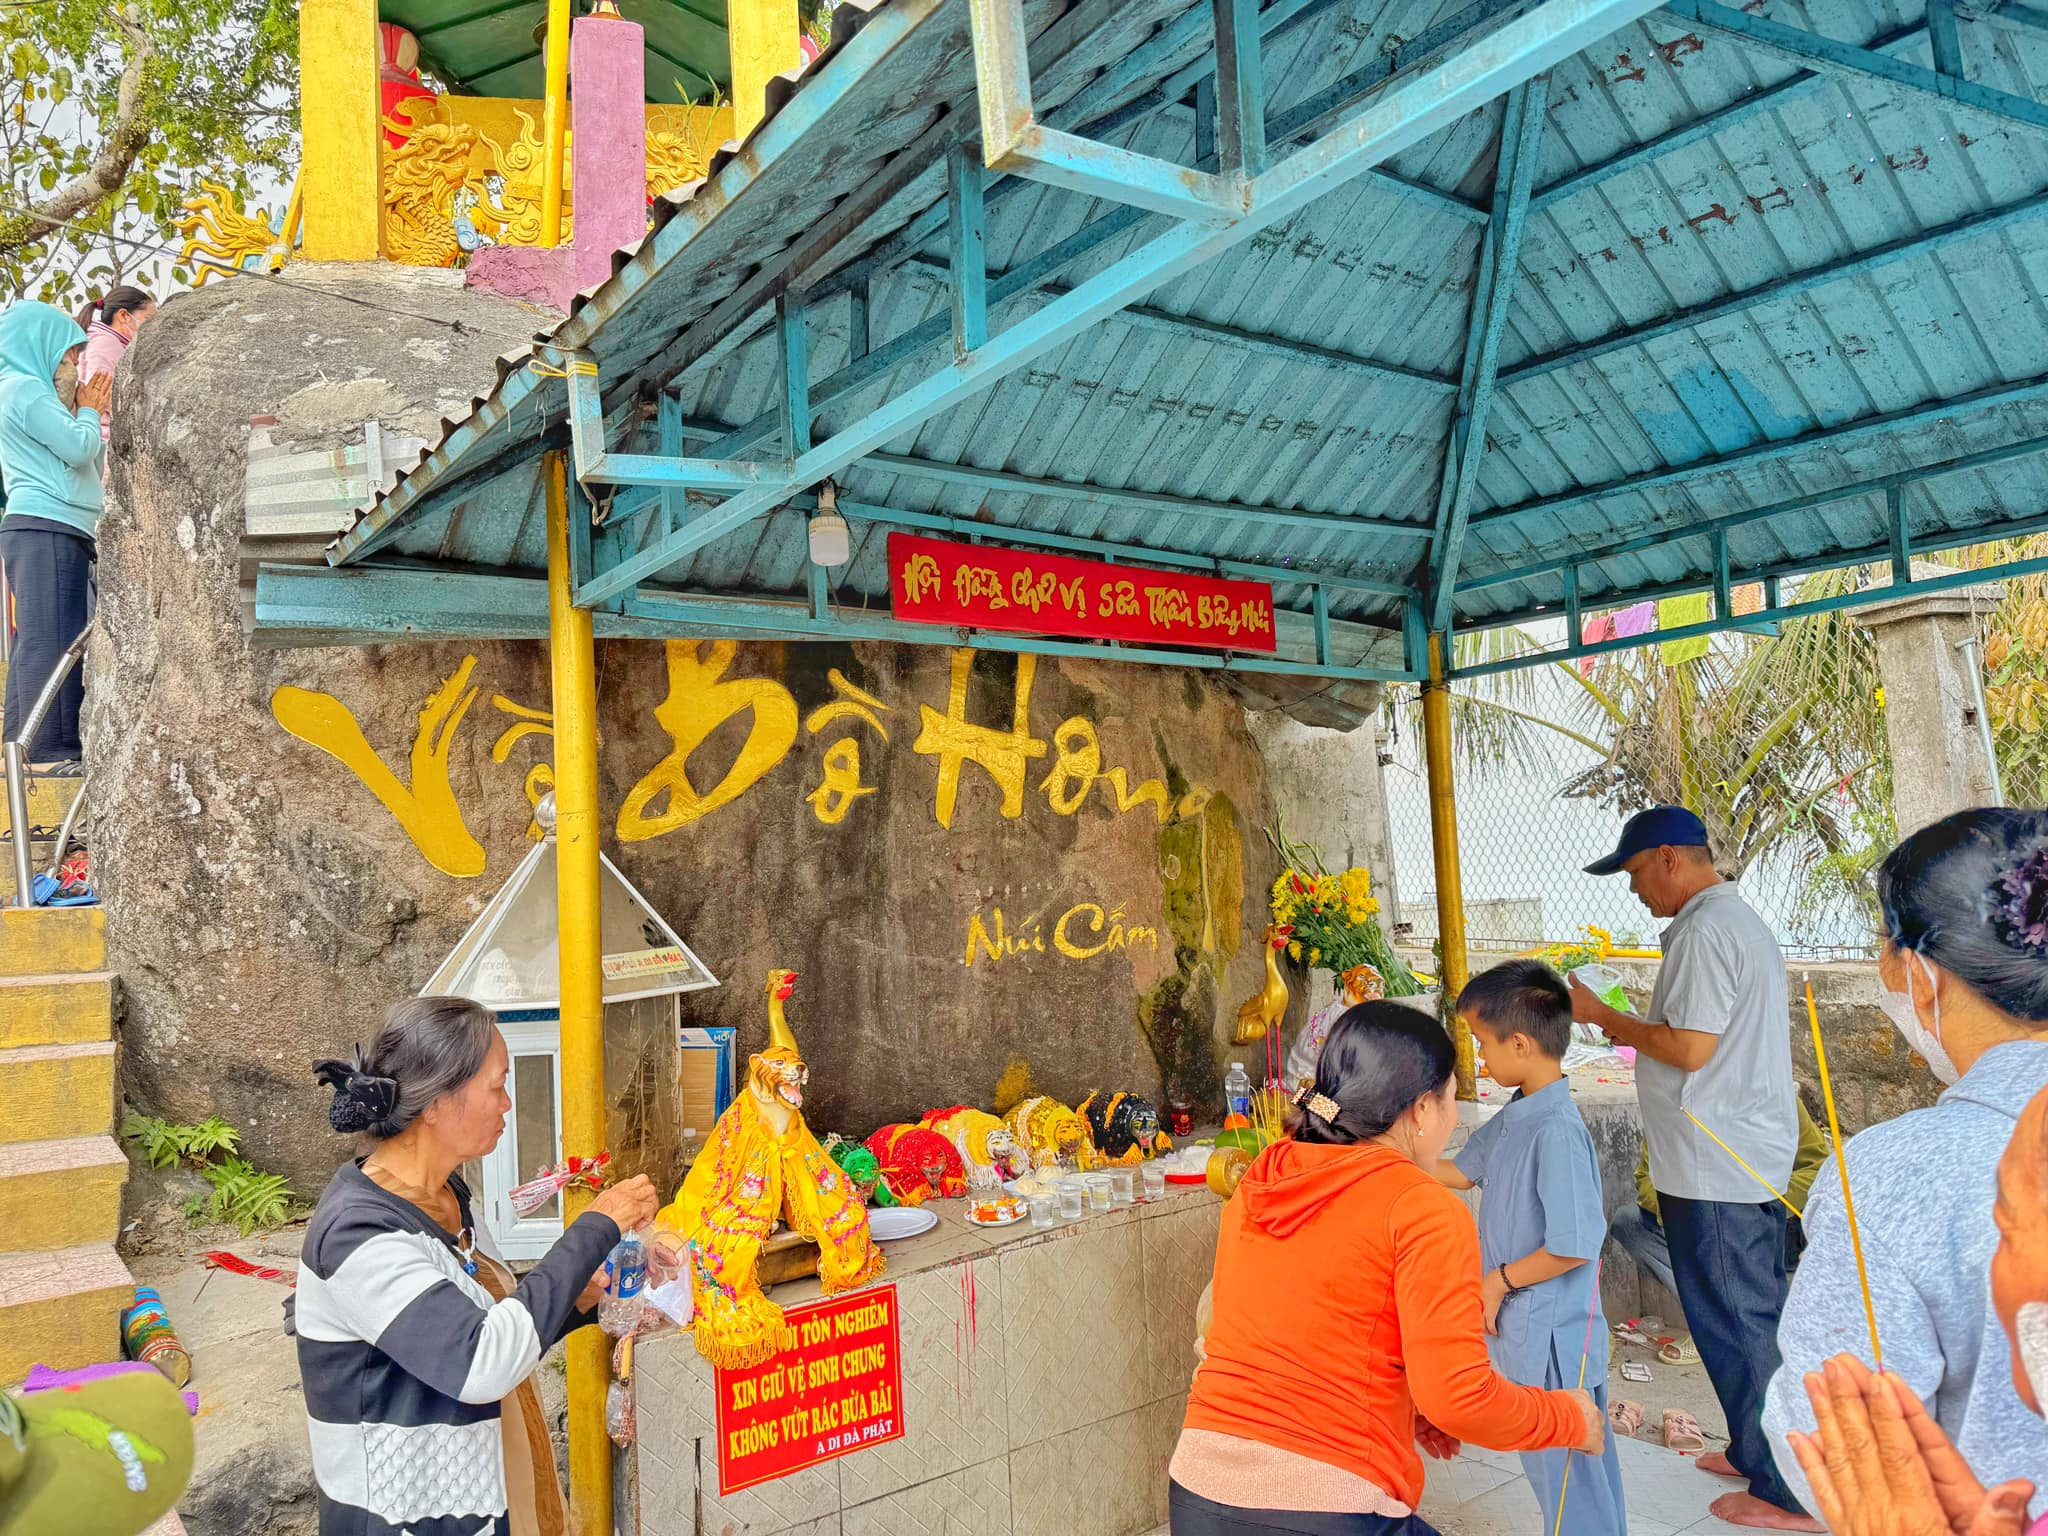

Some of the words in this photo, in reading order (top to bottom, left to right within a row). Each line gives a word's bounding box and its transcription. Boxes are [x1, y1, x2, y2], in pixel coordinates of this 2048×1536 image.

[901, 552, 941, 604] Hội
[953, 564, 1009, 610] Đồng
[1060, 576, 1088, 619] Vị
[1144, 586, 1195, 629] Thần
[965, 907, 1046, 968] Núi
[1053, 901, 1159, 960] Cấm
[801, 1313, 831, 1347] TÔN
[834, 1298, 889, 1339] NGHIÊM
[732, 1378, 757, 1412] XIN
[760, 1363, 785, 1402] GIỮ
[788, 1358, 806, 1399] VỆ
[808, 1355, 839, 1388] SINH
[841, 1343, 886, 1379] CHUNG
[729, 1418, 779, 1460] KHÔNG
[781, 1405, 809, 1443] VỨT
[811, 1397, 839, 1435] RÁC
[841, 1389, 868, 1425] BỪA
[870, 1381, 893, 1416] BÃI
[816, 1441, 826, 1455] A
[828, 1436, 841, 1451] DI
[843, 1427, 861, 1446] ĐÀ
[862, 1419, 893, 1438] PHẬT
